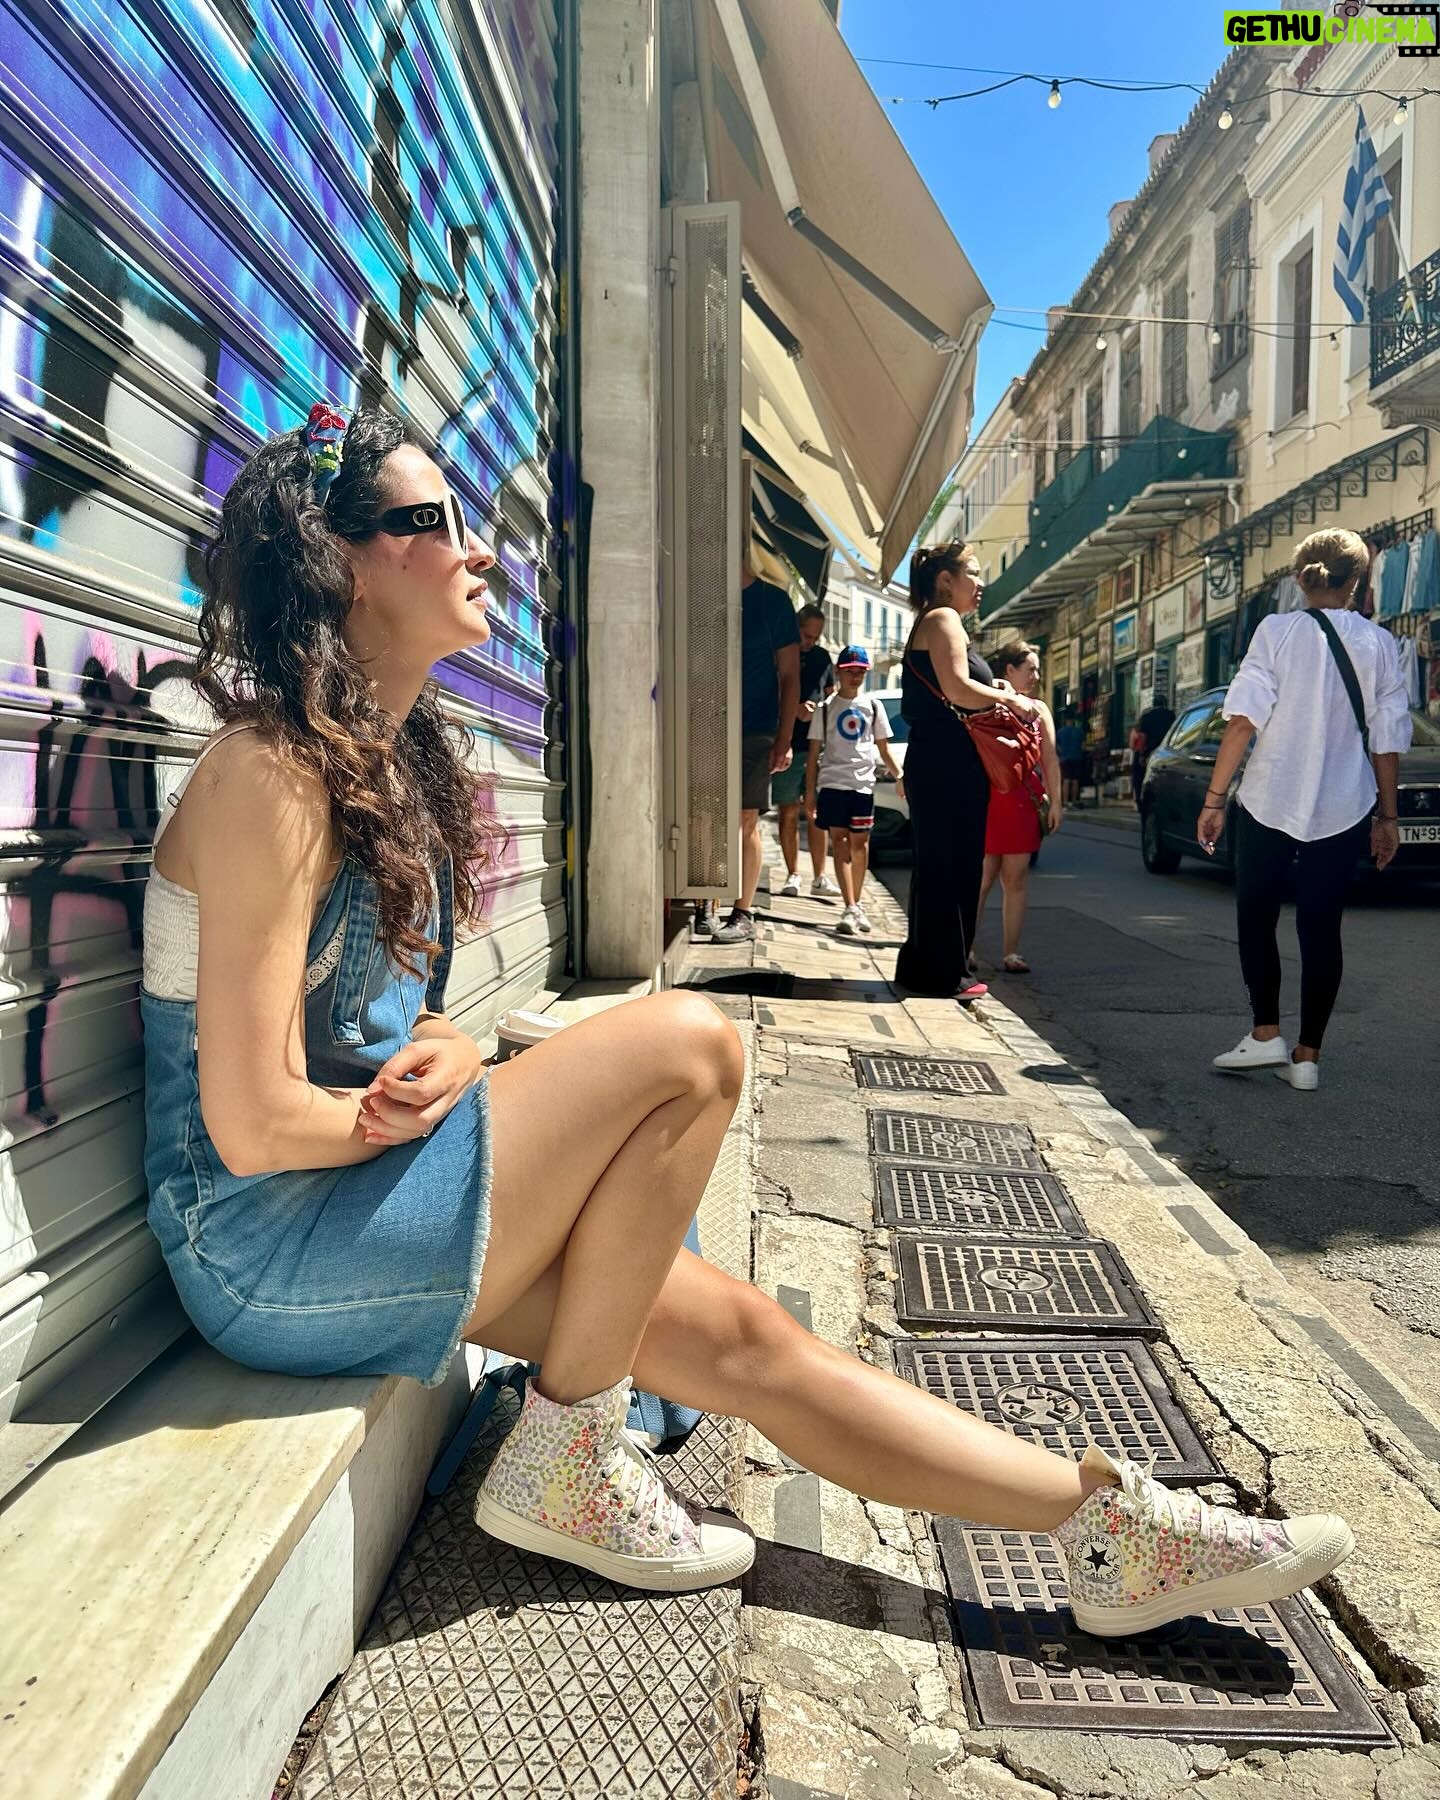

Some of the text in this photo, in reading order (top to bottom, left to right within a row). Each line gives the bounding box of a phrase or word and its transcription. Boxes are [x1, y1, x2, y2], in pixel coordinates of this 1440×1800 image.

[1076, 1535, 1111, 1559] CONVERSE
[1090, 1571, 1105, 1580] ALL
[1105, 1563, 1120, 1580] STAR
